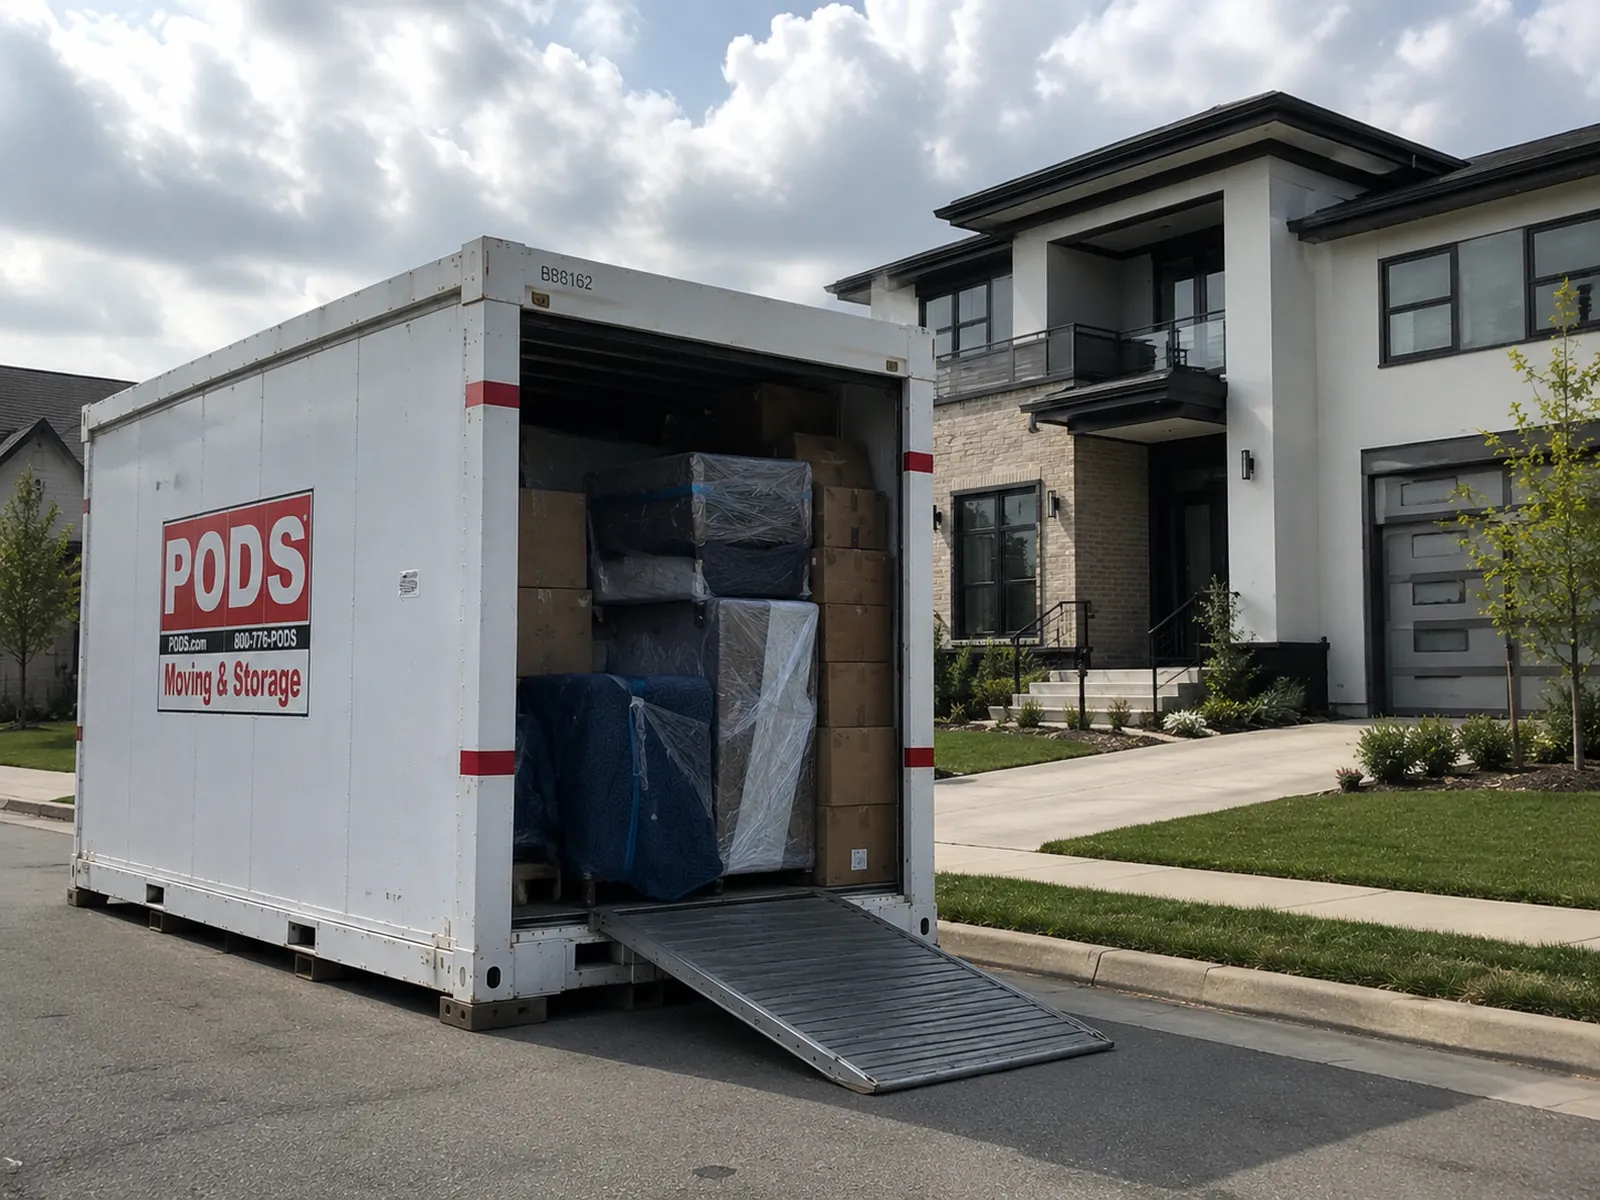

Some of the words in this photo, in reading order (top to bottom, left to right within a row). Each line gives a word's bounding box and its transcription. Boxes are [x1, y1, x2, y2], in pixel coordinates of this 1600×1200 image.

[164, 515, 306, 615] PODS
[168, 635, 207, 652] PODS.com
[234, 628, 297, 649] 800-776-PODS
[164, 661, 212, 706] Moving
[216, 661, 228, 697] &
[233, 660, 301, 708] Storage
